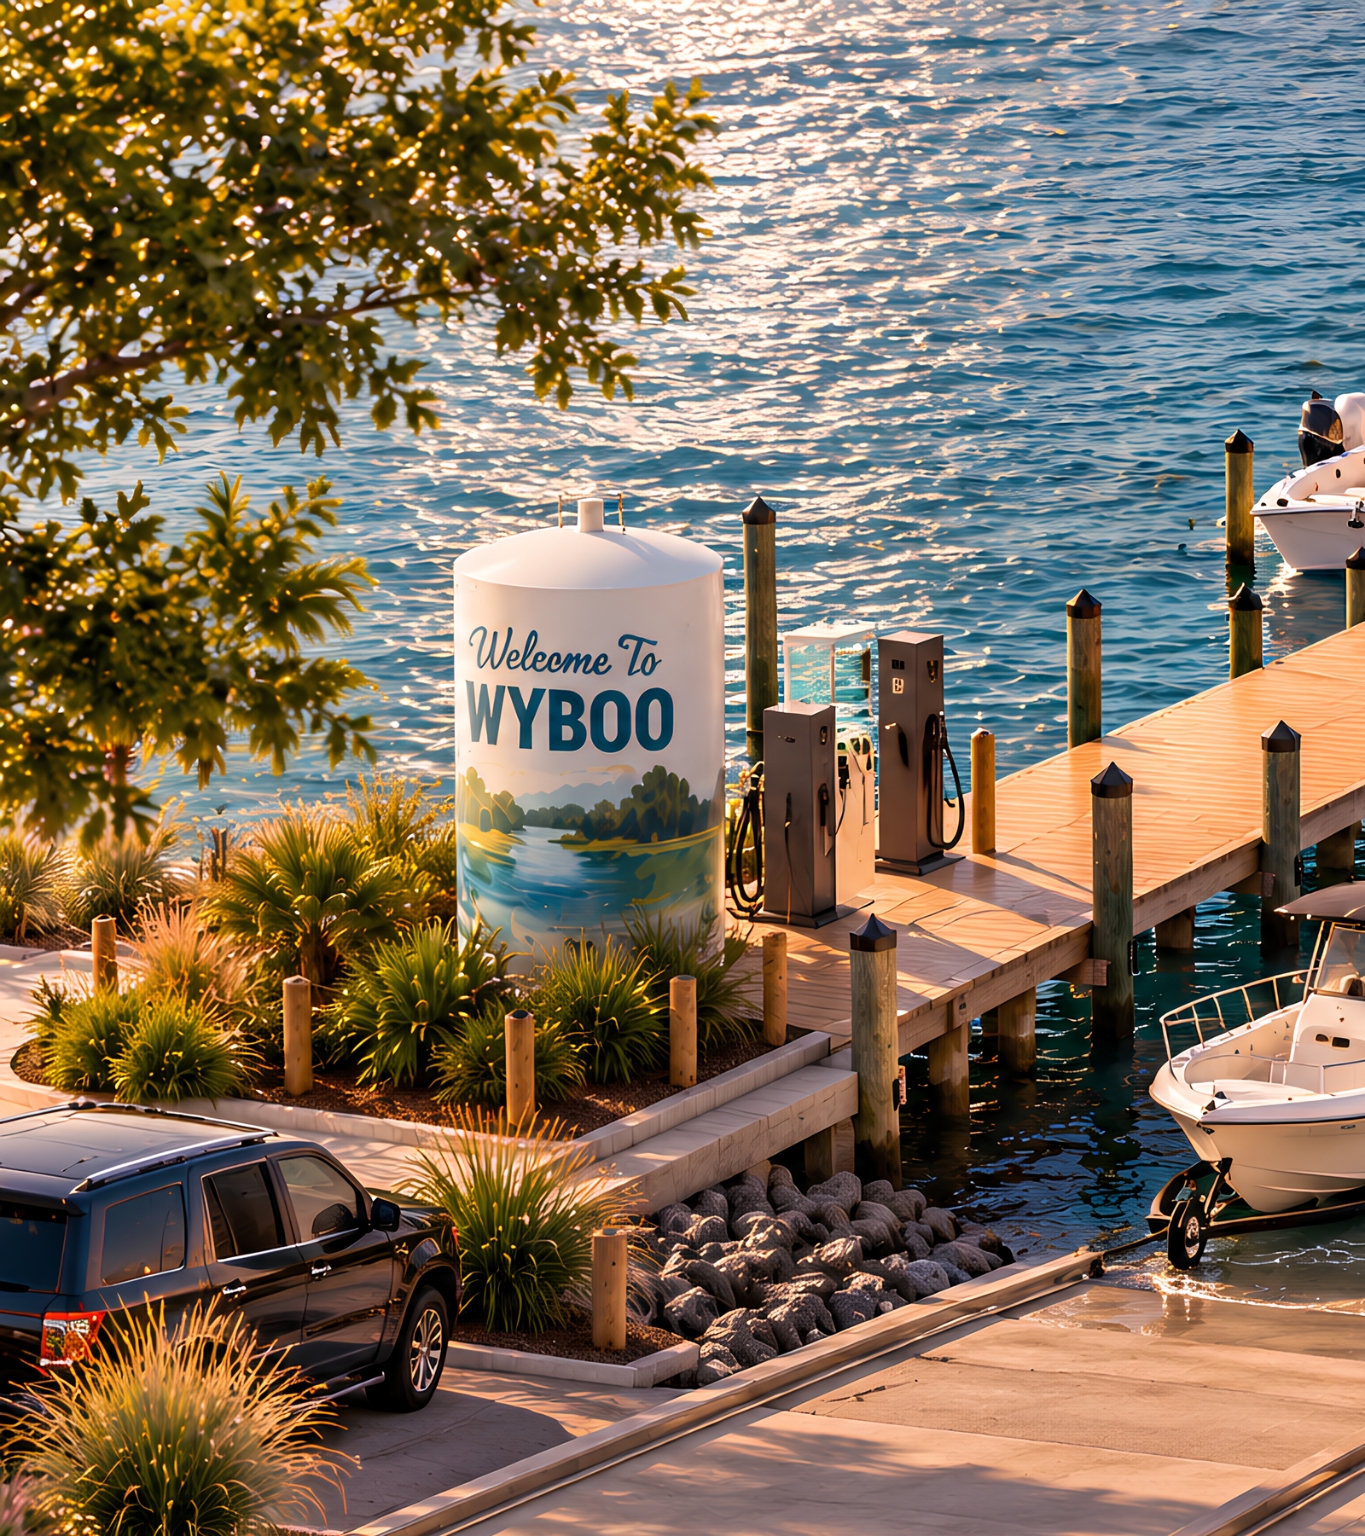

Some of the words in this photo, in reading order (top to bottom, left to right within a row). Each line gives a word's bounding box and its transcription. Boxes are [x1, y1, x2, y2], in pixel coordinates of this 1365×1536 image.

[469, 625, 612, 676] Welcome
[618, 633, 662, 676] To
[465, 680, 674, 753] WYBOO
